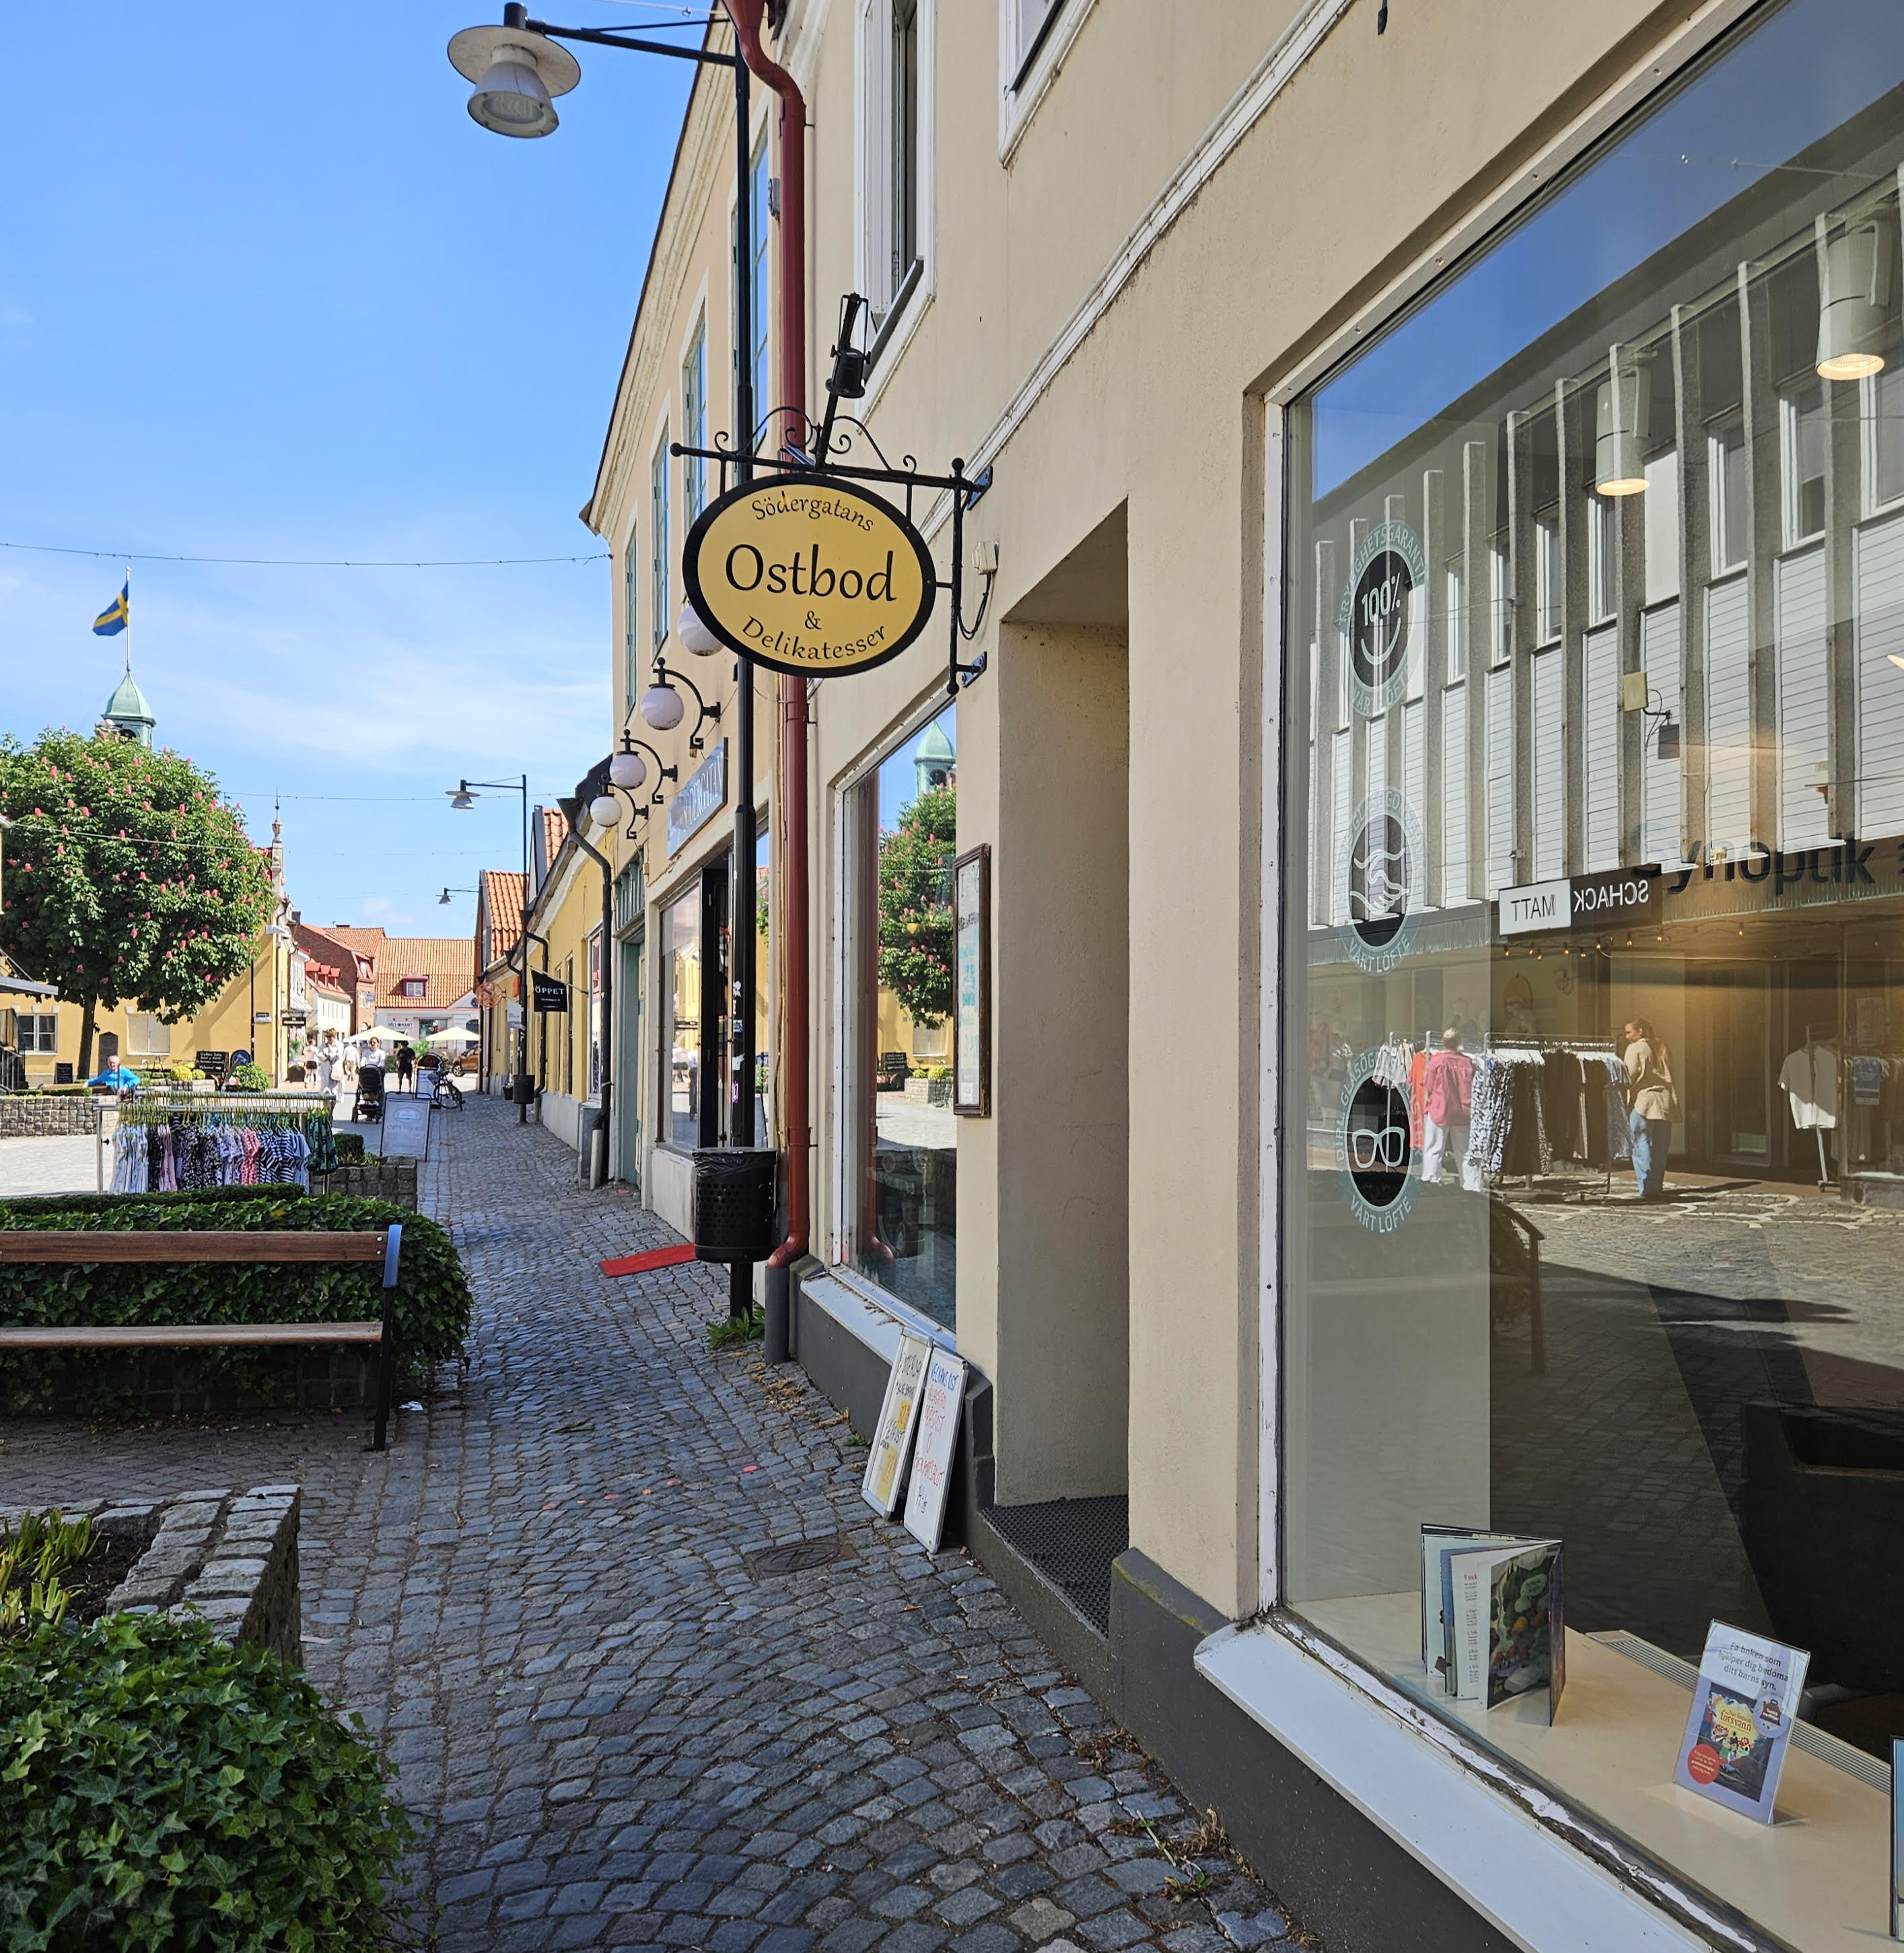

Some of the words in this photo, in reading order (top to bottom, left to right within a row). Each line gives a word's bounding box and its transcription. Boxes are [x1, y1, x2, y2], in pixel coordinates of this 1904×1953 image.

[751, 490, 874, 532] Södergatans
[725, 543, 897, 602] Ostbod
[1361, 572, 1401, 627] 100%
[804, 610, 822, 630] &
[742, 614, 886, 660] Delikatesser
[1349, 938, 1372, 971] VÅRT
[1376, 933, 1410, 973] LÖFTE
[534, 985, 565, 995] ÖPPET
[1350, 1195, 1377, 1232] VÅRT
[1378, 1196, 1413, 1234] LÖFTE
[1740, 1646, 1764, 1660] boken
[1765, 1656, 1782, 1668] som
[1744, 1660, 1757, 1672] dig
[1758, 1664, 1789, 1682] bedöma
[1724, 1664, 1738, 1676] ditt
[1738, 1669, 1761, 1684] barns
[1761, 1679, 1777, 1691] syn.
[1720, 1709, 1752, 1732] försvann
